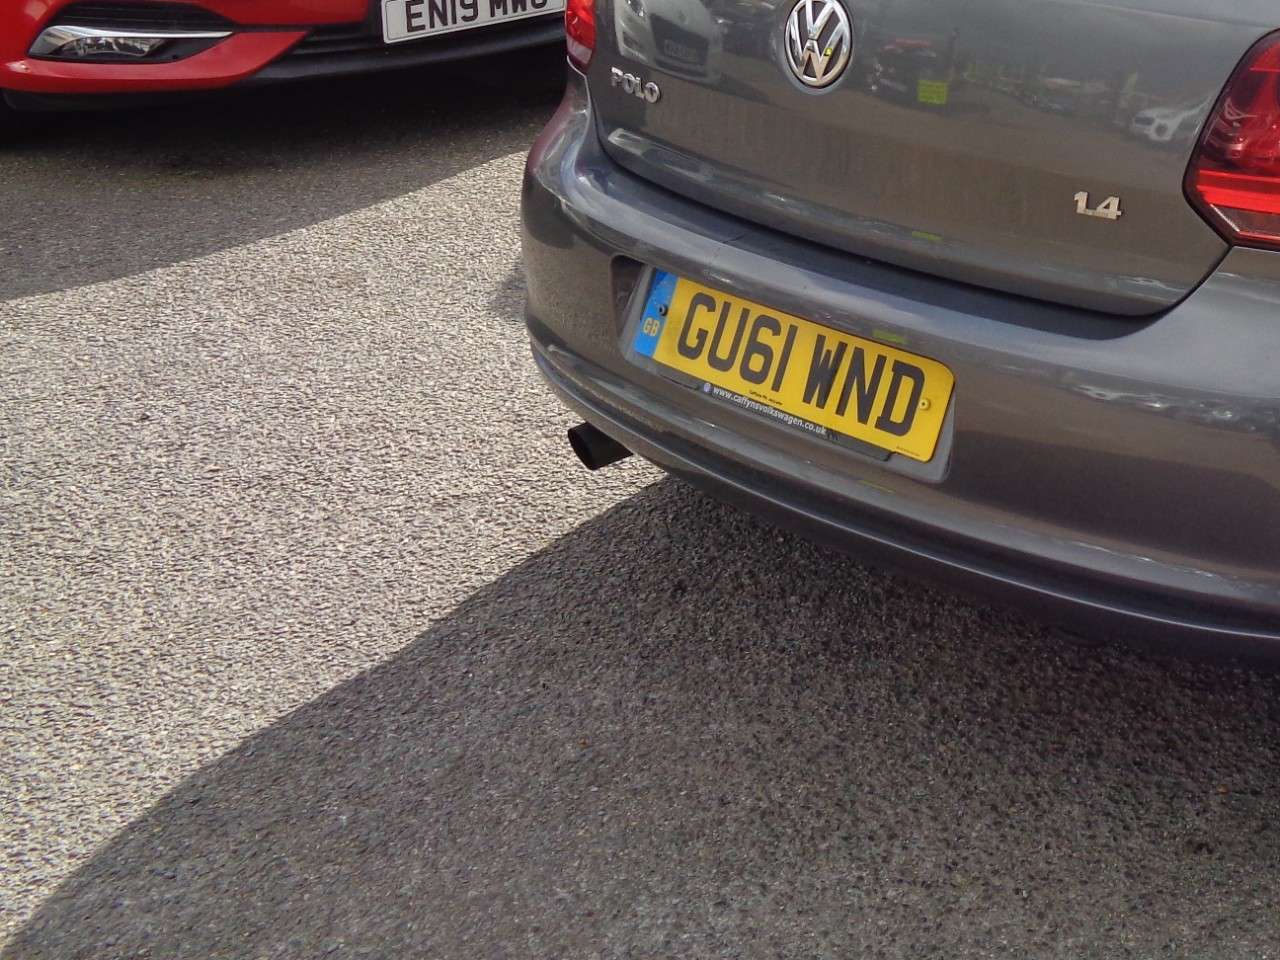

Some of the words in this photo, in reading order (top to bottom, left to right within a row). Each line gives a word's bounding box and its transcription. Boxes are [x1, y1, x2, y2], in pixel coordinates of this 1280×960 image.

[610, 66, 660, 103] POLO
[642, 317, 661, 337] GB
[676, 291, 799, 393] GU61
[801, 333, 926, 438] WND
